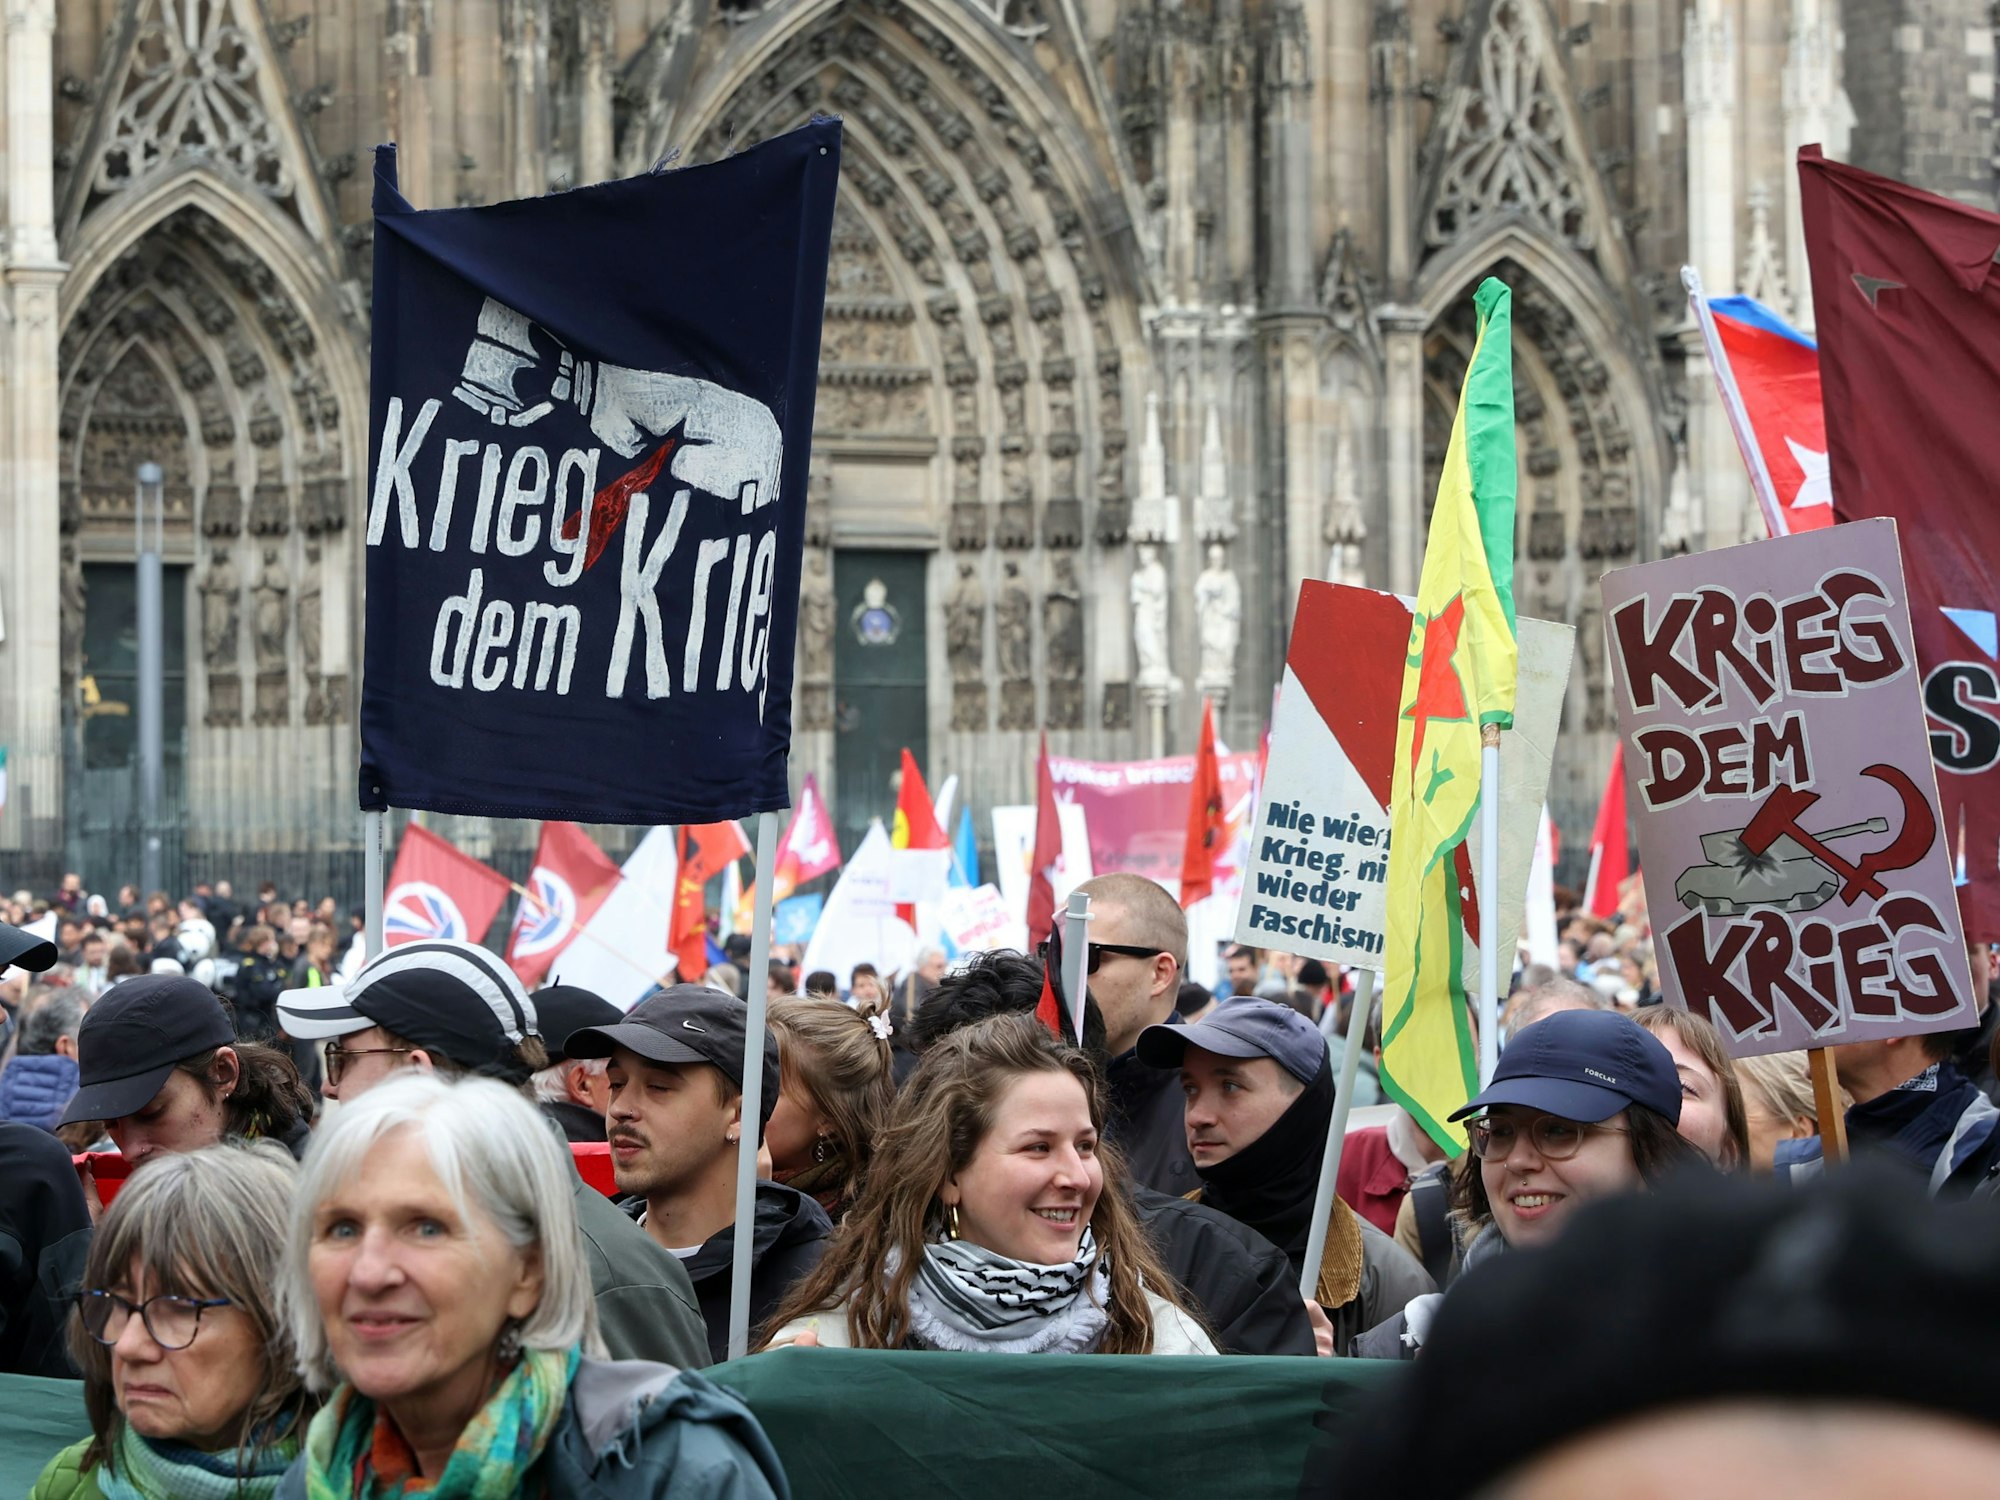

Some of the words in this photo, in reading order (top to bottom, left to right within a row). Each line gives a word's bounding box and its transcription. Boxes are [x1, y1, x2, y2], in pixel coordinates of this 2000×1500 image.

[366, 397, 600, 587] Krieg
[430, 568, 581, 695] dem
[606, 489, 777, 727] Krie
[1631, 710, 1815, 811] DEM
[1266, 800, 1315, 834] Nie
[1257, 870, 1362, 911] wieder
[1357, 853, 1388, 884] ni
[1249, 904, 1386, 955] Faschism
[1584, 1067, 1617, 1085] FORCLAZ
